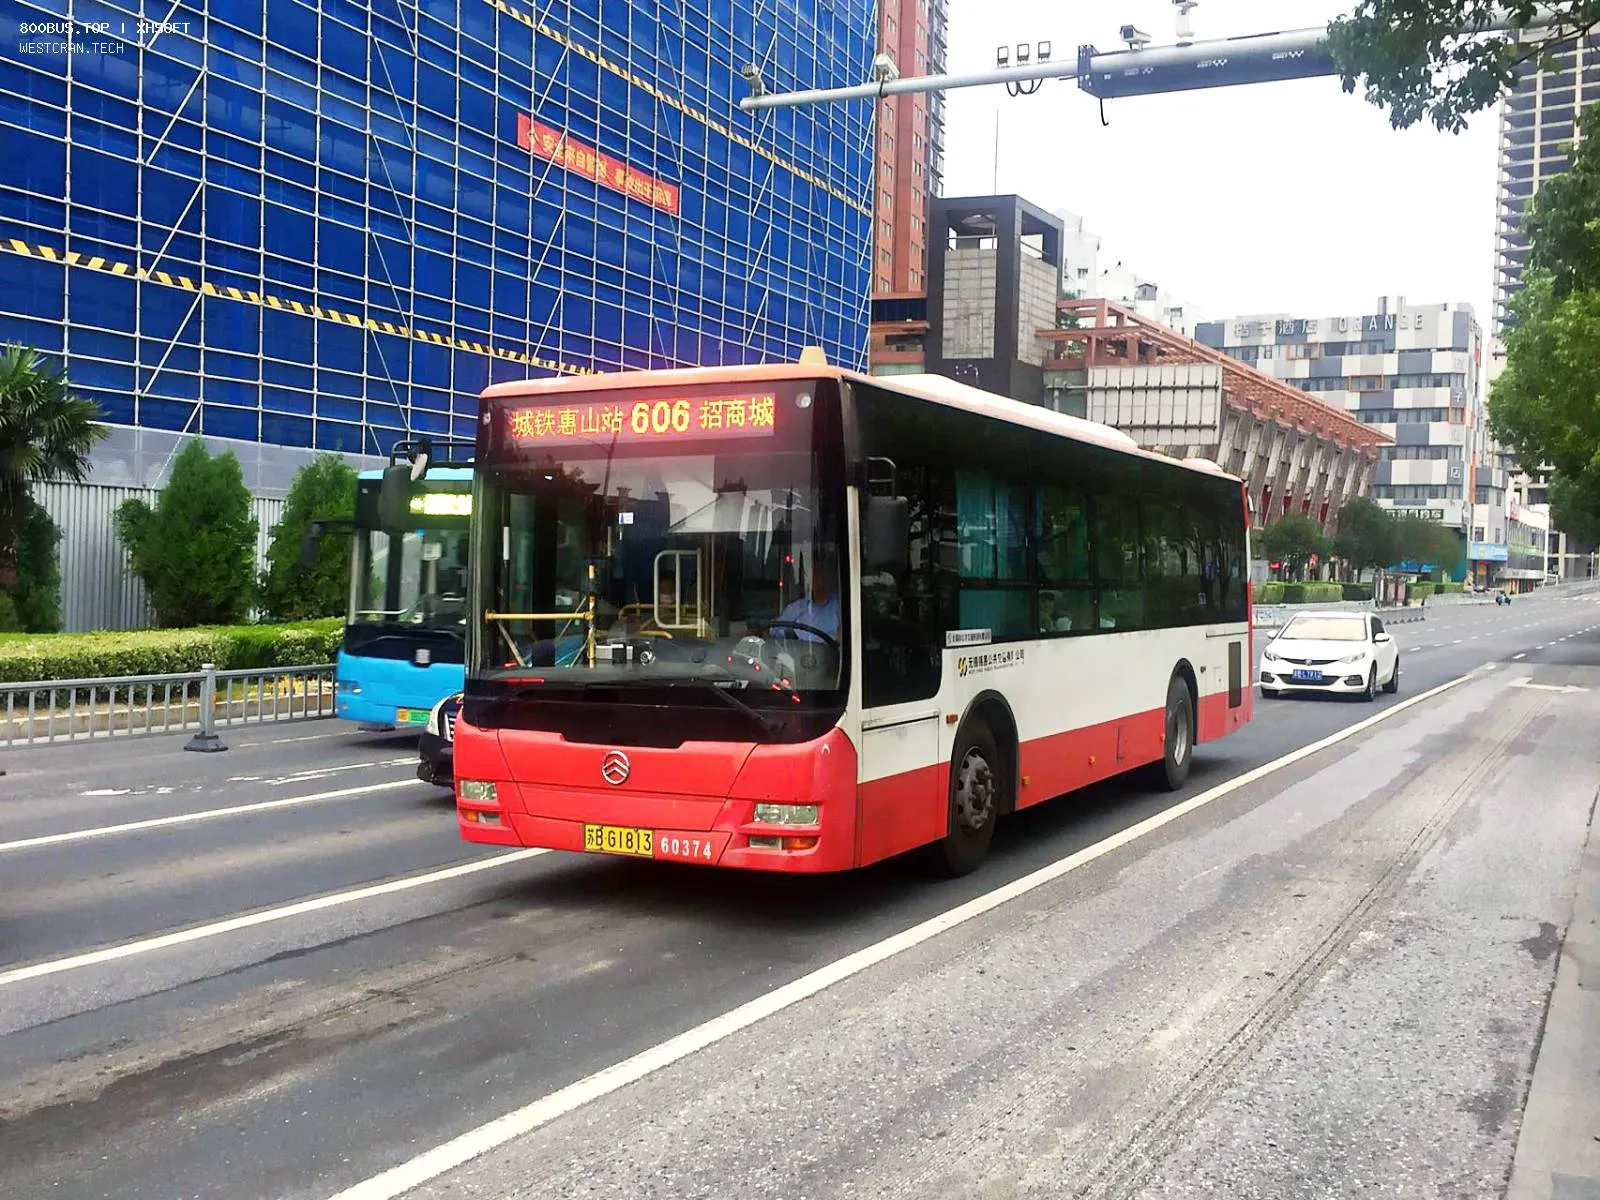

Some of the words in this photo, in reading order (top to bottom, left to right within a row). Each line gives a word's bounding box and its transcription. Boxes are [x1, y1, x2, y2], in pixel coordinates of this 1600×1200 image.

[511, 406, 623, 438] 城铁惠山站
[631, 399, 691, 434] 606
[699, 394, 775, 429] 招商城
[660, 836, 712, 860] 60374
